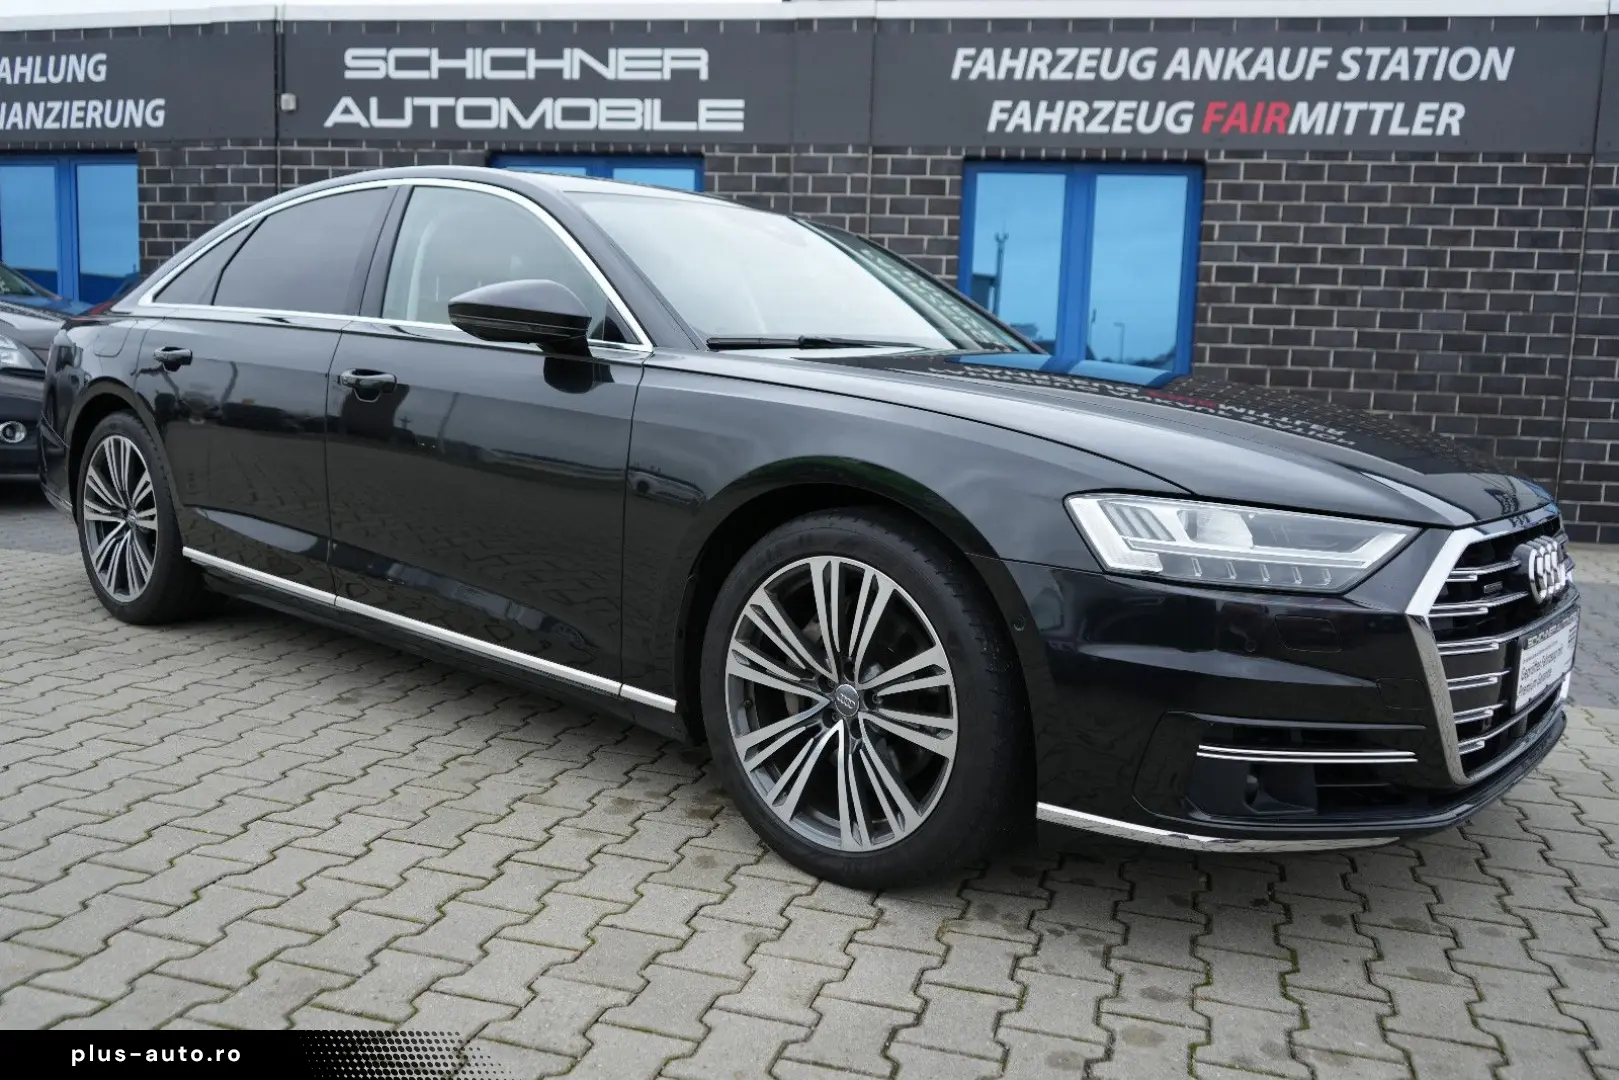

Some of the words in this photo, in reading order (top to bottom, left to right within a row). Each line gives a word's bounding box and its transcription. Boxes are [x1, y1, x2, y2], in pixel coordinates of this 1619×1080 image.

[343, 47, 710, 82] SCHICHNER
[950, 46, 1157, 82] FAHRZEUG
[1163, 46, 1332, 82] ANKAUF
[1336, 46, 1516, 82] STATION
[323, 95, 746, 133] AUTOMOBILE
[986, 99, 1196, 135] FAHRZEUG
[1201, 100, 1466, 137] FAIRMITTLER
